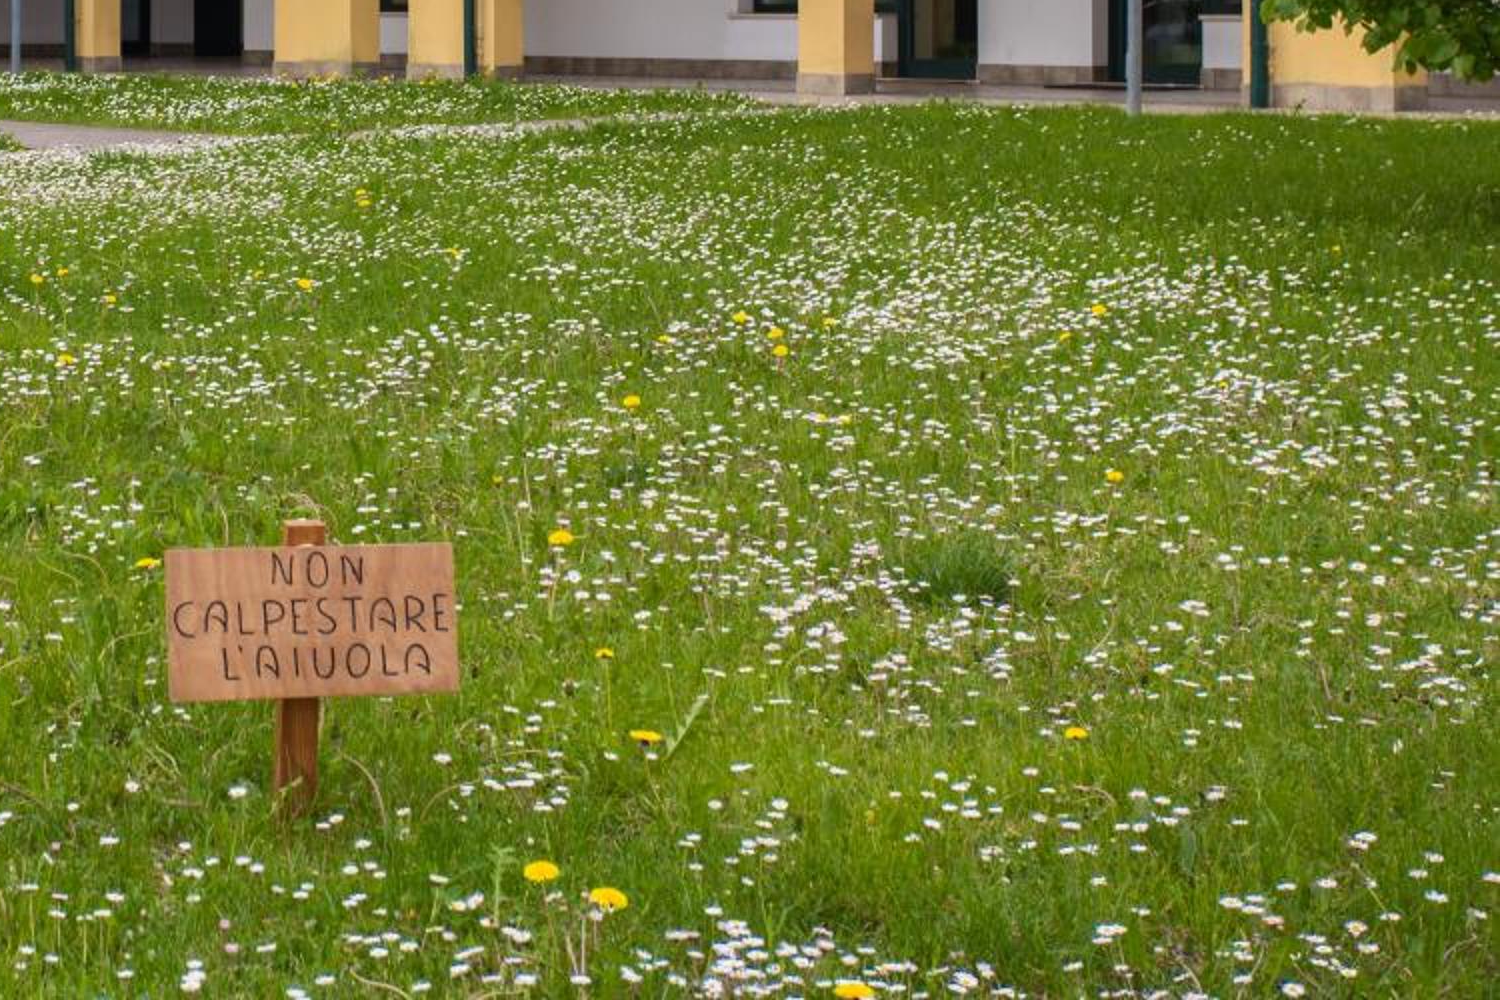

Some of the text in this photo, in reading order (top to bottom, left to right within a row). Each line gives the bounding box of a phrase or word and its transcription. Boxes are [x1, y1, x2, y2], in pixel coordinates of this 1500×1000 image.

[271, 551, 365, 588] NON
[173, 594, 450, 638] CALPESTARE
[222, 643, 431, 681] L'AIUOLA
